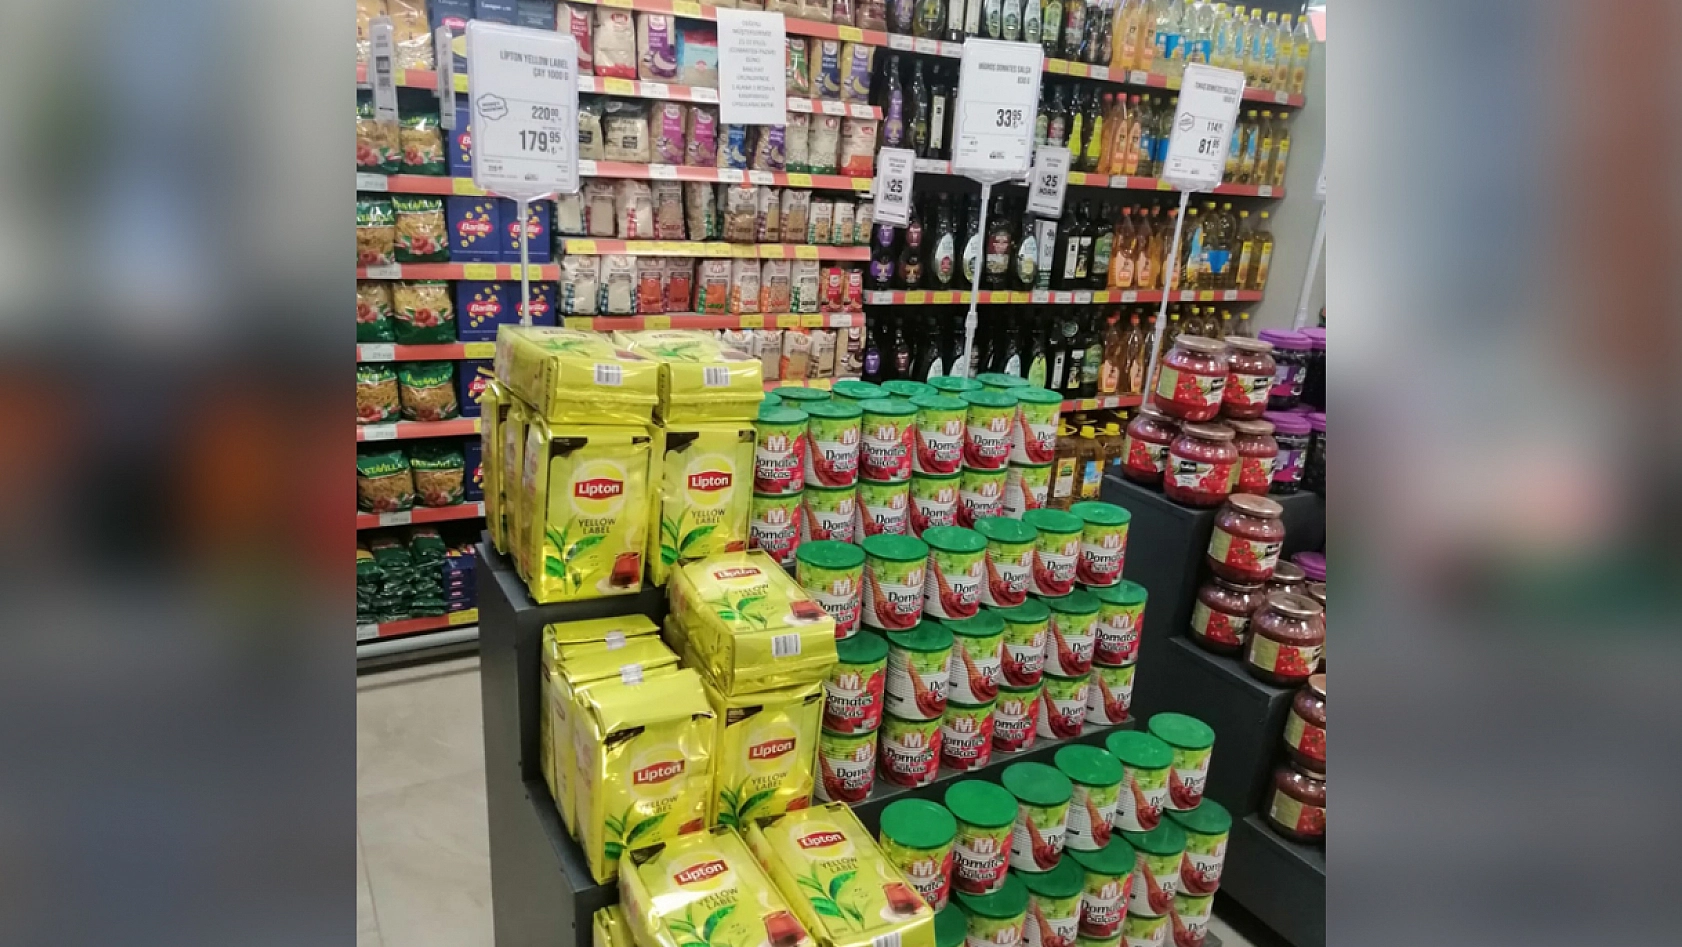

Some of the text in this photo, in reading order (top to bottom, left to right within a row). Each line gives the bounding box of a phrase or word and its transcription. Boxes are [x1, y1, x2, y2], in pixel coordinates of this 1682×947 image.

[500, 50, 568, 69] LIPTON YELLOW LABEL
[531, 105, 551, 121] 220
[945, 420, 961, 436] M
[991, 417, 1007, 432] M
[843, 429, 857, 443] M
[879, 426, 895, 440] M
[768, 435, 787, 451] M
[578, 481, 620, 497] Lipton
[691, 475, 729, 490] Lipton
[982, 483, 997, 497] M
[892, 494, 905, 510] M
[938, 488, 953, 502] M
[691, 508, 725, 518] YELLOW
[839, 500, 852, 515] M
[578, 517, 616, 527] YELLOW
[696, 516, 721, 524] LABEL
[767, 509, 785, 523] M
[583, 526, 610, 534] LABEL
[1103, 534, 1120, 549] M
[718, 568, 758, 578] Lipton
[907, 570, 922, 586] M
[833, 579, 851, 595] M
[1112, 615, 1129, 628] M
[839, 674, 859, 690] M
[1004, 701, 1021, 715] M
[955, 717, 973, 733] M
[904, 732, 923, 748] M
[752, 740, 793, 757] Lipton
[637, 763, 683, 783] Lipton
[752, 772, 787, 785] YELLOW
[755, 780, 782, 791] LABEL
[802, 832, 843, 846] Lipton
[974, 837, 994, 853] M
[819, 856, 857, 868] YELLOW
[830, 863, 857, 873] LABEL
[912, 860, 933, 876] M
[679, 862, 724, 882] Lipton
[699, 887, 738, 904] YELLOW
[1101, 883, 1117, 899] M
[706, 896, 737, 907] LABEL
[996, 927, 1015, 944] M
